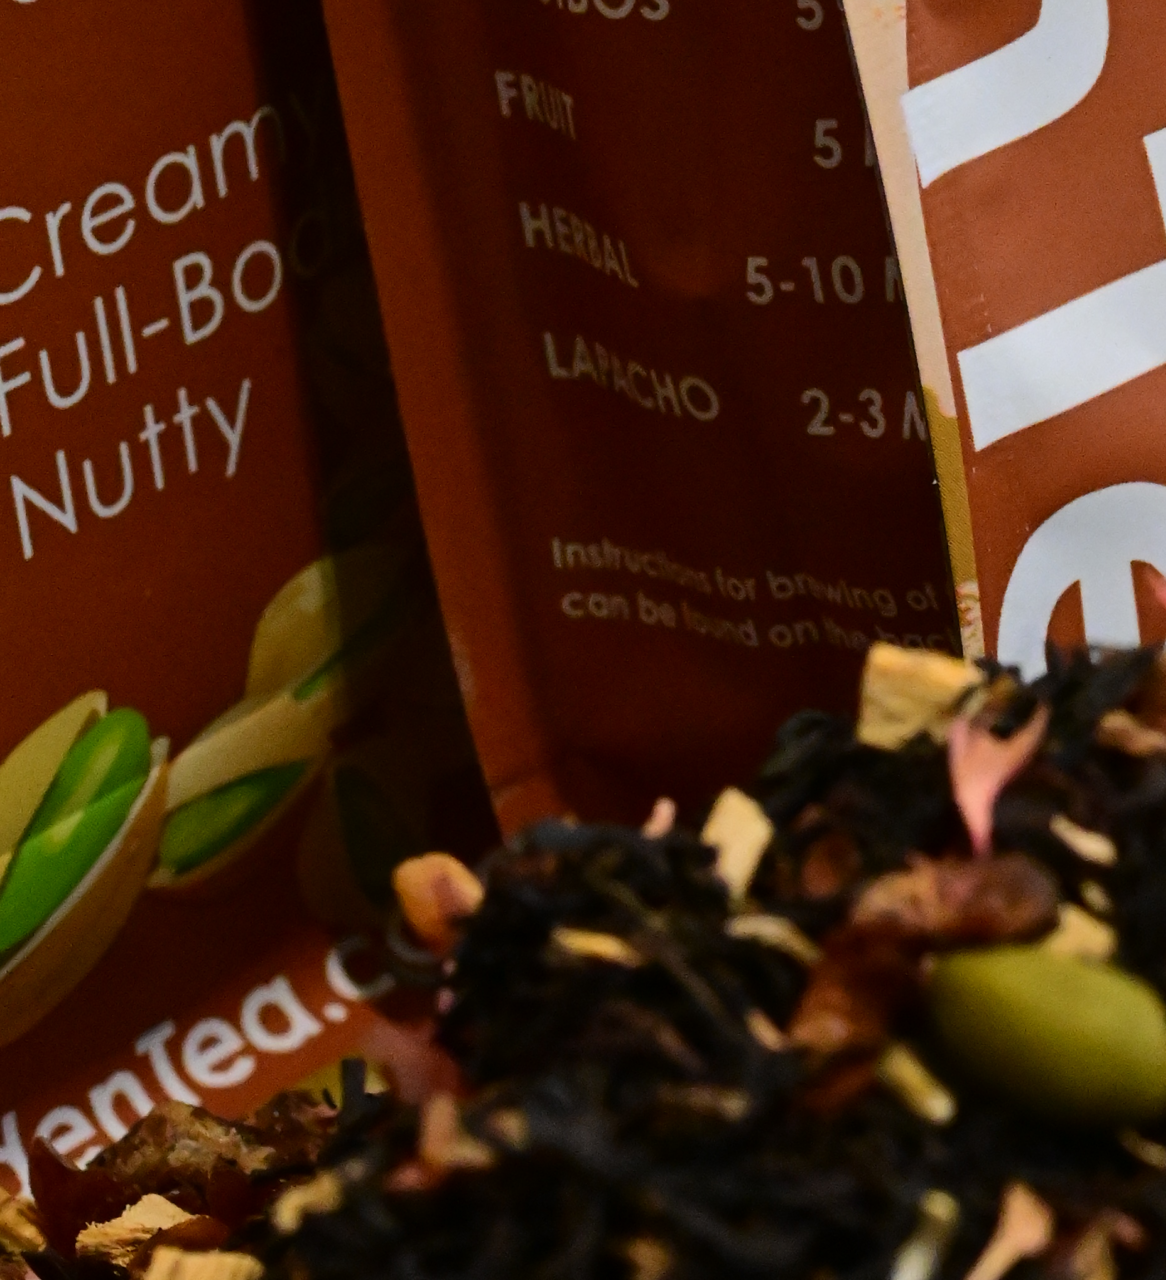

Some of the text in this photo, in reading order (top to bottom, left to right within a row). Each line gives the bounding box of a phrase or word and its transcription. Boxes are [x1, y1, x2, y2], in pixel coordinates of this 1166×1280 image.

[494, 70, 577, 142] FRUIT
[812, 118, 843, 169] 5
[518, 201, 640, 289] HERBAL
[745, 255, 866, 306] 5-10
[542, 330, 721, 422] LAPACHO
[800, 387, 887, 439] 2-3
[10, 377, 252, 561] Nutty
[551, 535, 712, 596] Instructions
[714, 566, 757, 602] for
[766, 568, 897, 617] brewing
[561, 589, 630, 620] can
[637, 591, 677, 628] be
[768, 619, 820, 649] on
